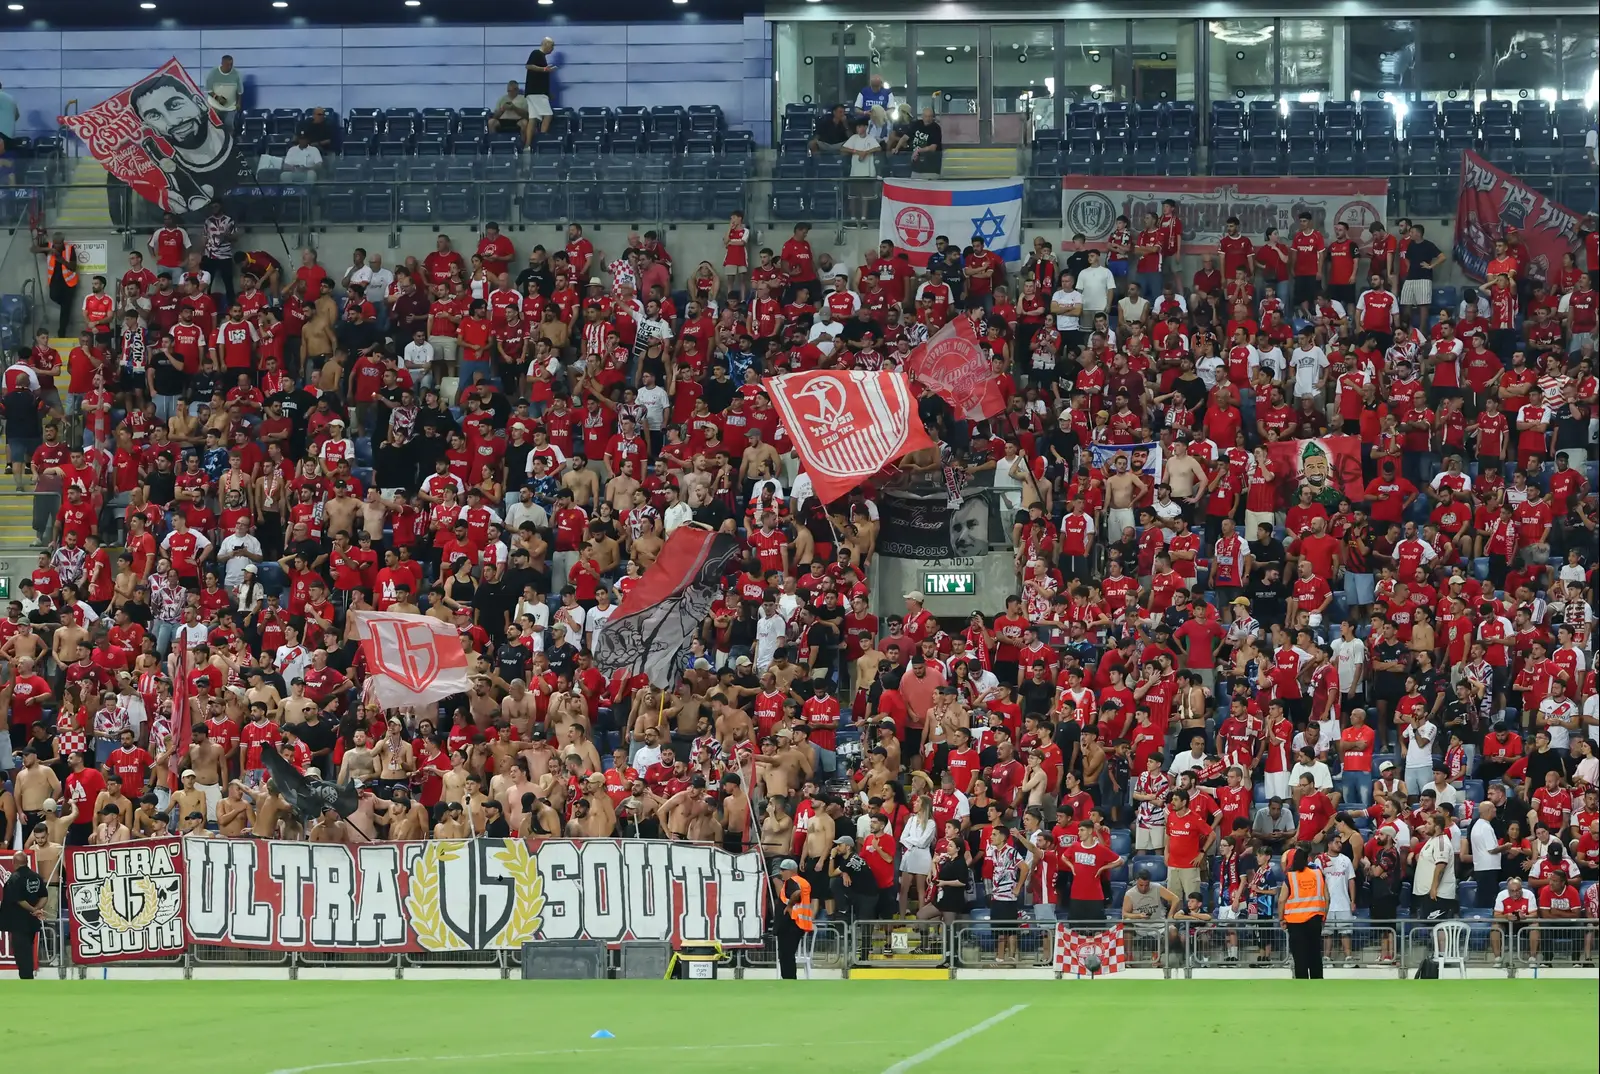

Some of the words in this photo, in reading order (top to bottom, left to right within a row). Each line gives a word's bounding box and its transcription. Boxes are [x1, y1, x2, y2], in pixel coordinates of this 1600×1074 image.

[1501, 180, 1537, 216] באר
[1160, 201, 1278, 239] UCHACHOS
[925, 341, 952, 369] SUPPORT
[953, 340, 971, 356] YOUR
[822, 432, 839, 447] שבע
[440, 515, 453, 523] JVC
[884, 542, 949, 557] 1978-2013
[950, 557, 975, 567] כניסה
[927, 574, 971, 593] יציאה
[1451, 750, 1462, 777] SHEVA
[536, 840, 765, 945] SOUTH
[79, 917, 184, 958] SOUTH
[893, 935, 905, 947] 2A
